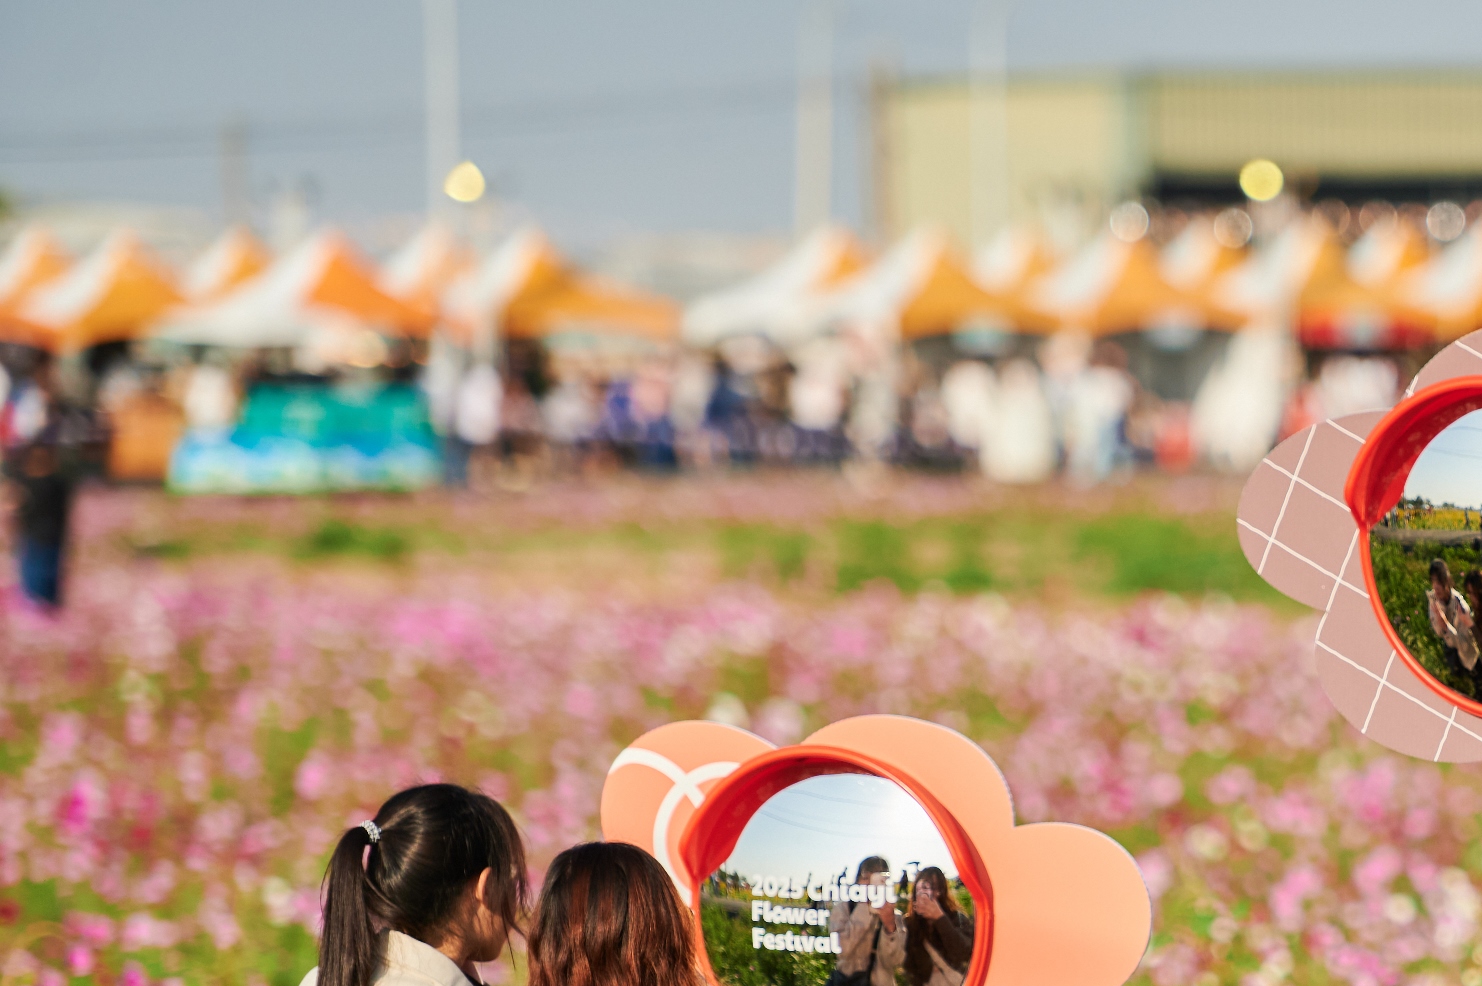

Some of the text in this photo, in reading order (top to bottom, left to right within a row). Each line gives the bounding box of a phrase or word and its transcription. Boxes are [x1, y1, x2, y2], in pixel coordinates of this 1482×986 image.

[751, 874, 897, 908] 2025 Chiayi
[751, 900, 830, 926] Flower
[751, 927, 842, 954] Festival
